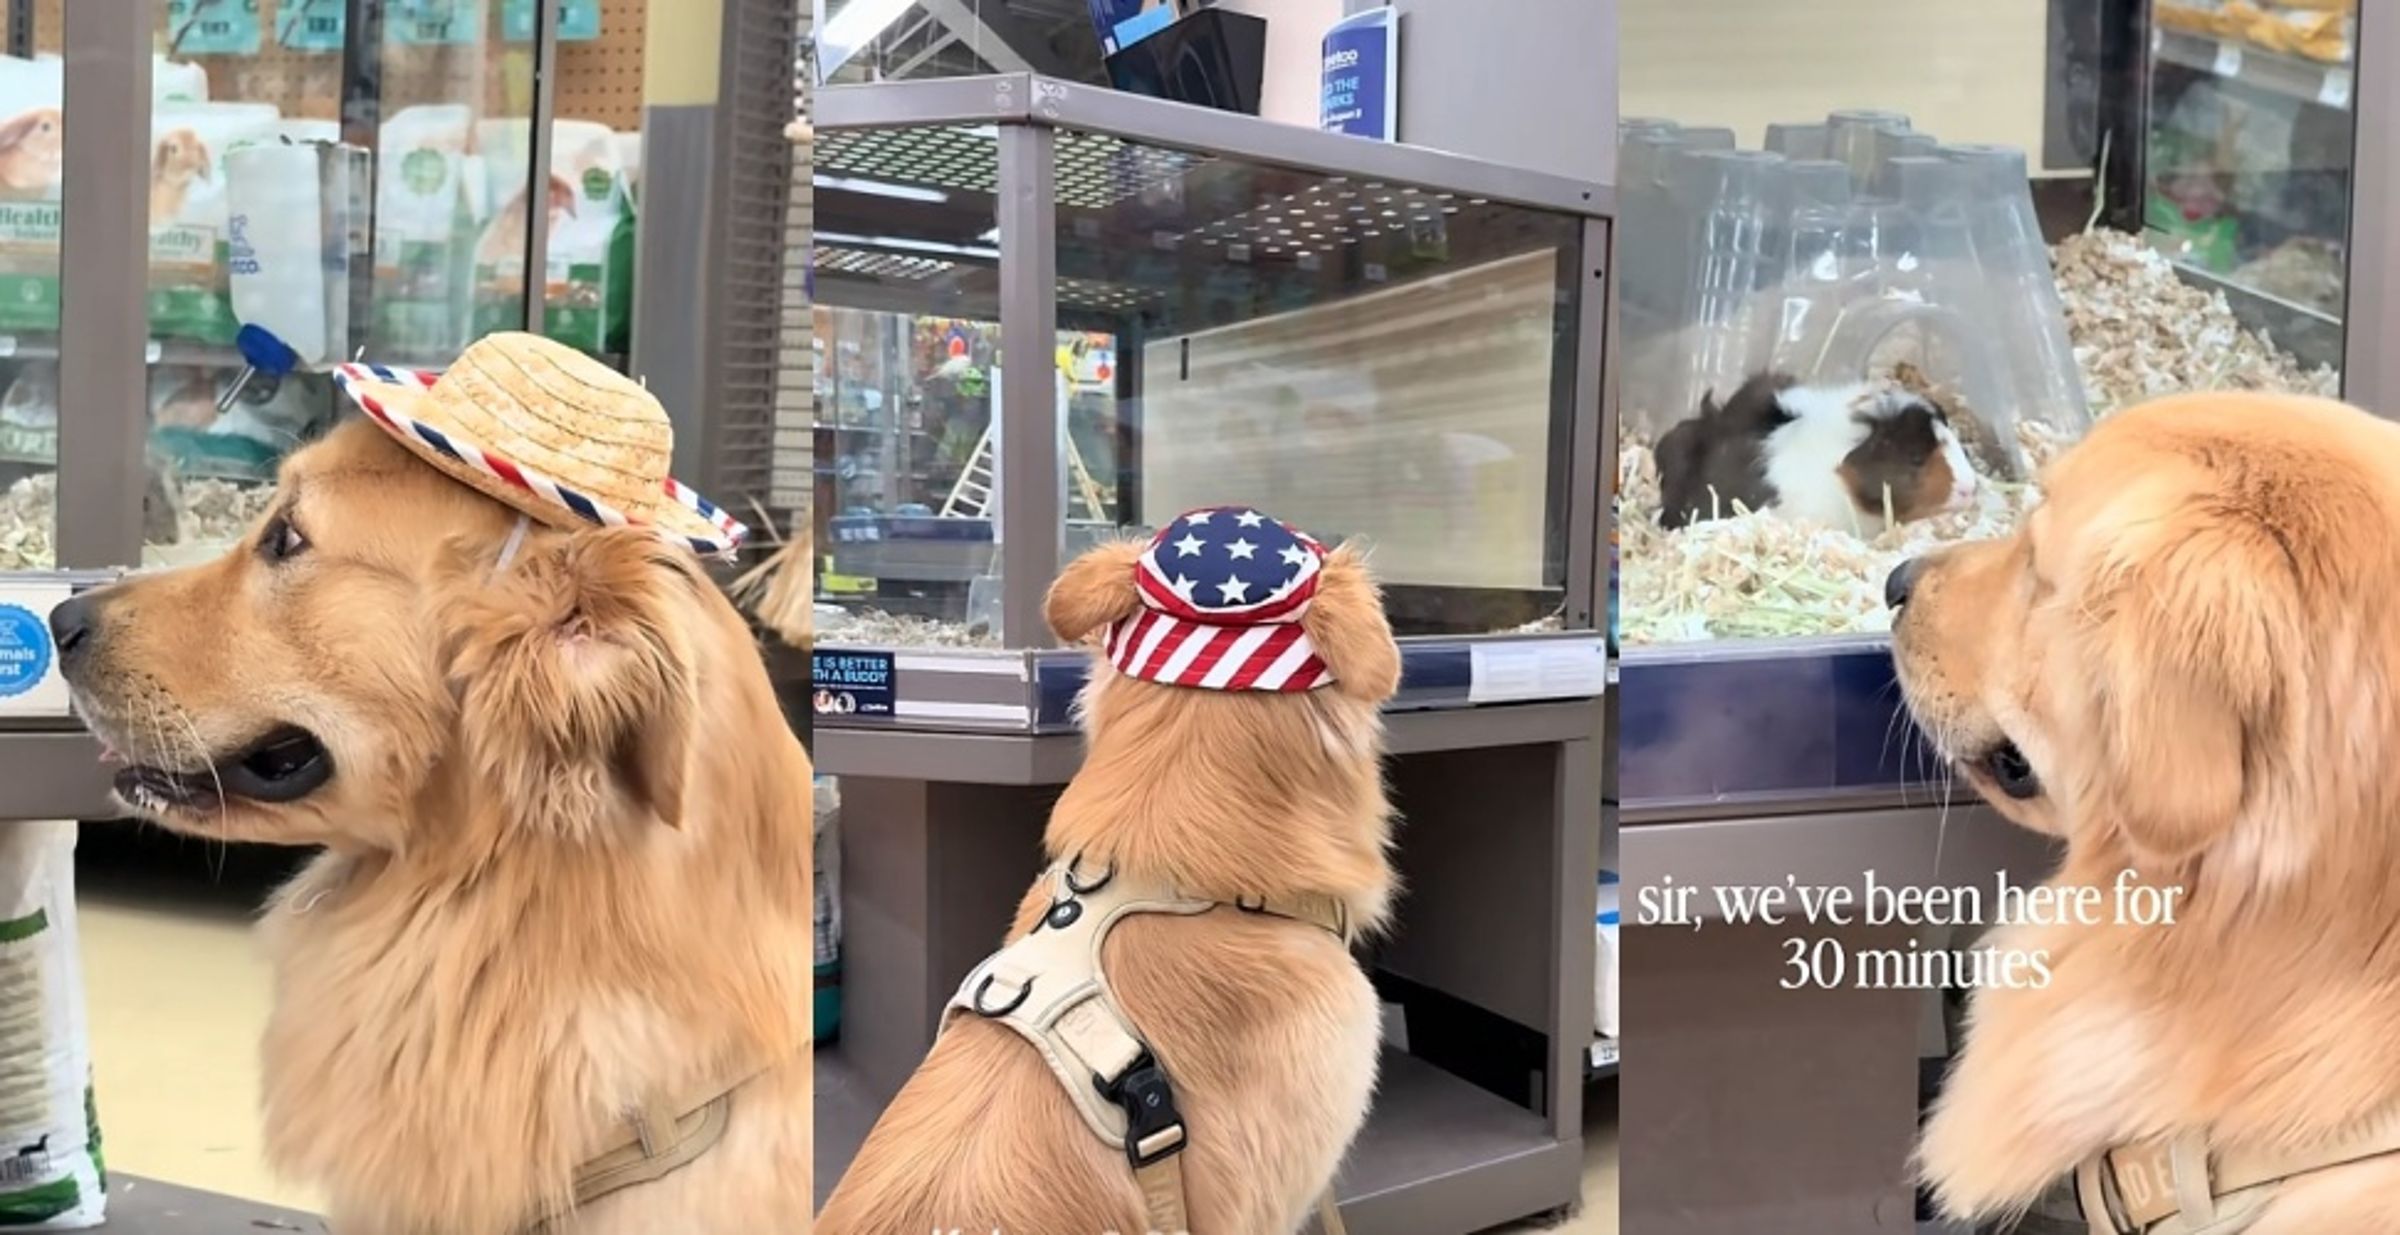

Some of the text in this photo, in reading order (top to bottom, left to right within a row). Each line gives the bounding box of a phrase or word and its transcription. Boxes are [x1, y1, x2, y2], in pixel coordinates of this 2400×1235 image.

[822, 656, 836, 669] IS
[839, 656, 888, 670] BETTER
[831, 669, 842, 681] A
[844, 670, 888, 684] BUDDY
